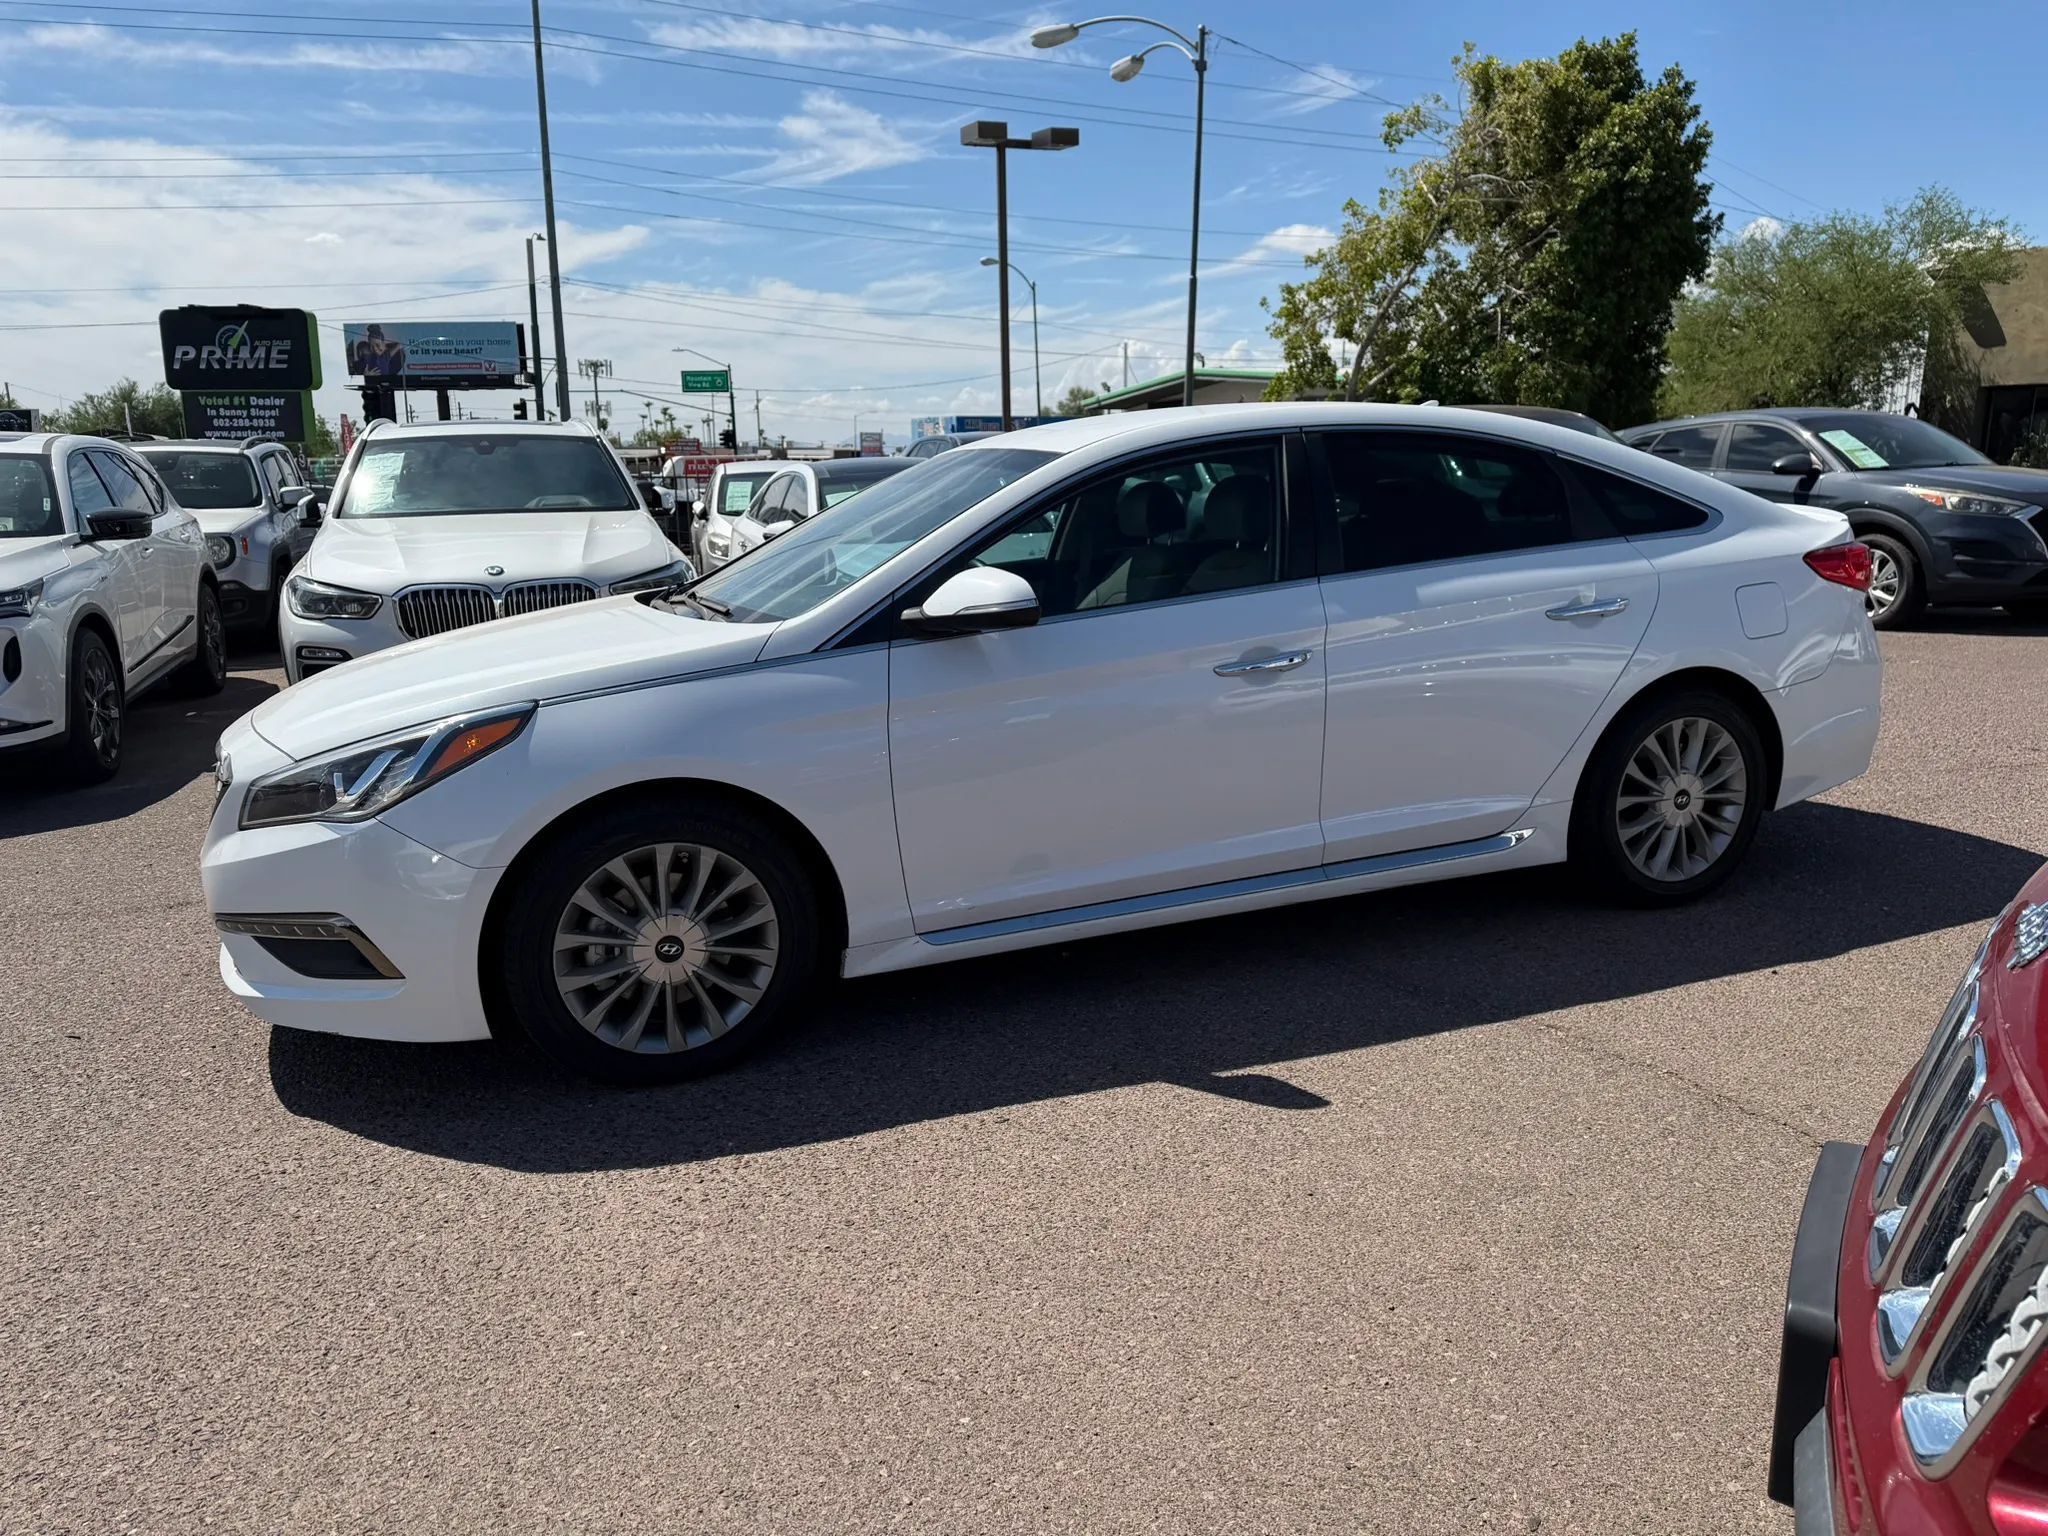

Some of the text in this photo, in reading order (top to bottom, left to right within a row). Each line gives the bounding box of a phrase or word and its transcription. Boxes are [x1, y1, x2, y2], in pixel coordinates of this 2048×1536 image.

[409, 338, 511, 348] Have room in your home
[421, 347, 431, 355] in
[432, 347, 453, 356] your
[455, 347, 483, 355] heart?
[173, 345, 291, 369] PRIME
[198, 396, 285, 405] Voted #1 Dealer
[207, 408, 279, 418] In Sunny Slope!
[204, 430, 285, 439] www.pauto1.com
